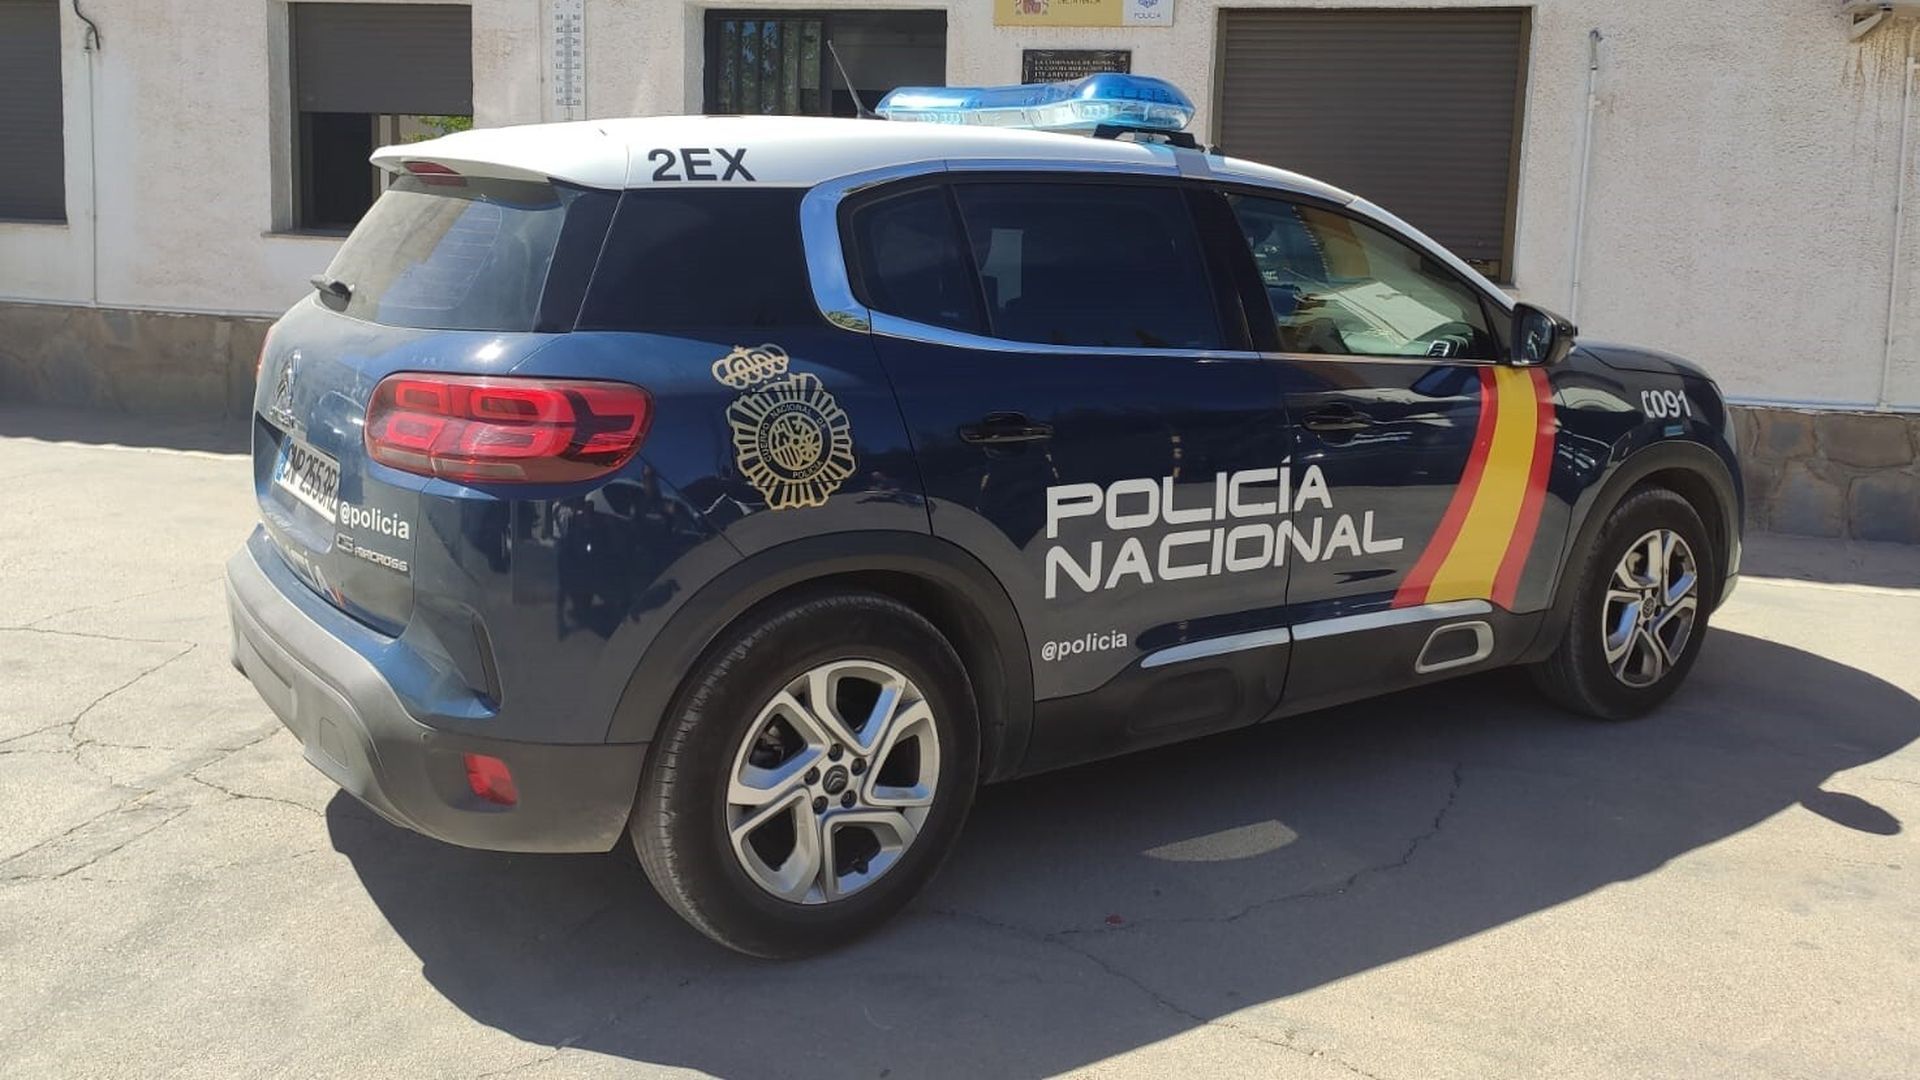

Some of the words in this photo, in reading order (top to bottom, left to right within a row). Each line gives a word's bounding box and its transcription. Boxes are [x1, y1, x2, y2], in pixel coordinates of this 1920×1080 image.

[647, 148, 757, 182] 2EX
[1046, 455, 1333, 539] POLICÍA
[340, 501, 410, 540] @policia
[1045, 510, 1404, 600] NACIONAL
[1041, 629, 1128, 662] @policia
